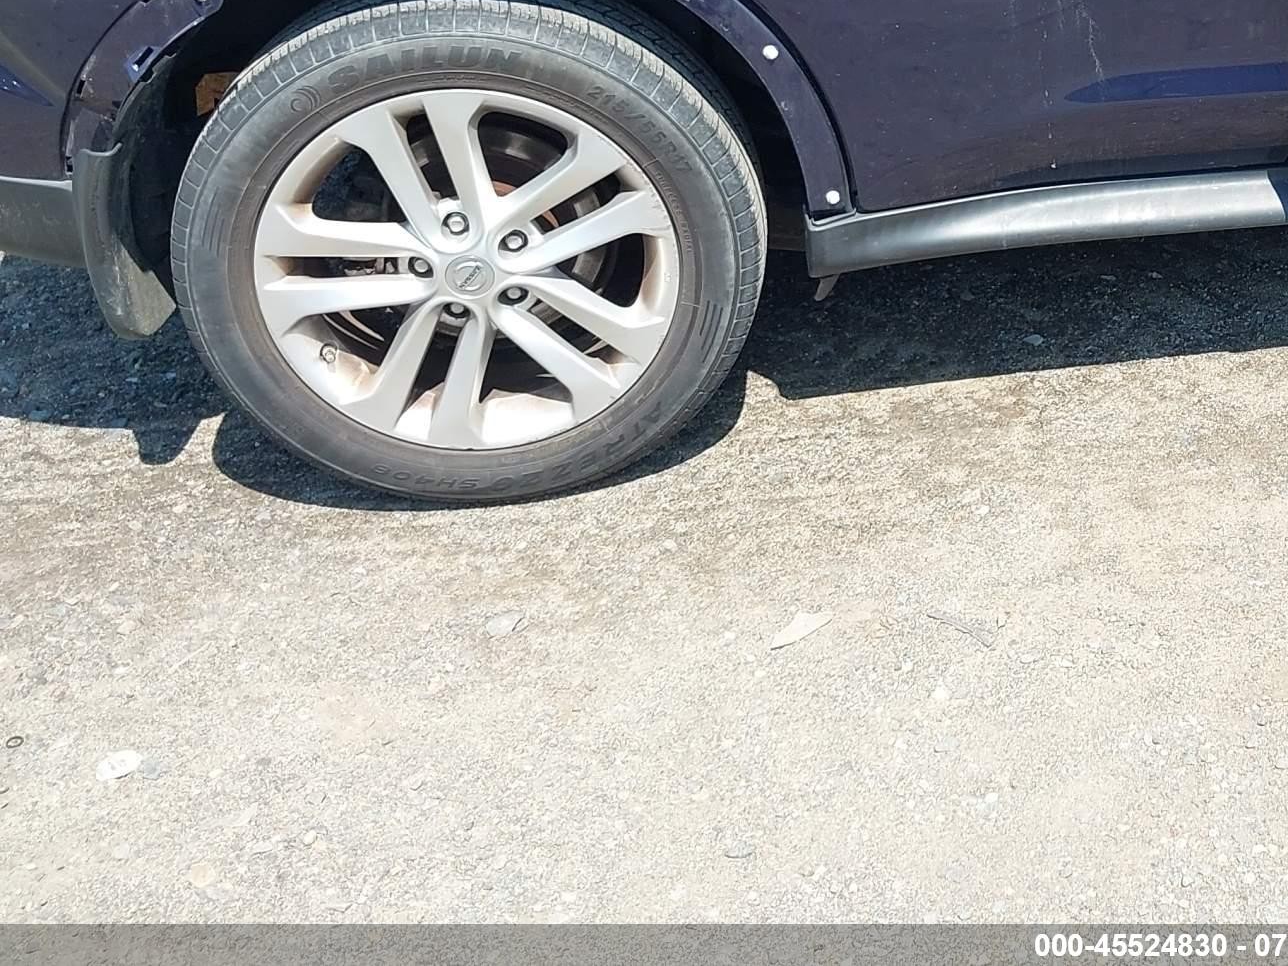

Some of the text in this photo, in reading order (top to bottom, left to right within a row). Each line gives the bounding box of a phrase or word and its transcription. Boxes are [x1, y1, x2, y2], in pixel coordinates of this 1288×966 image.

[328, 44, 522, 90] SAILUN
[586, 86, 693, 172] 215/55R17
[369, 401, 664, 490] ATREZZO SH408
